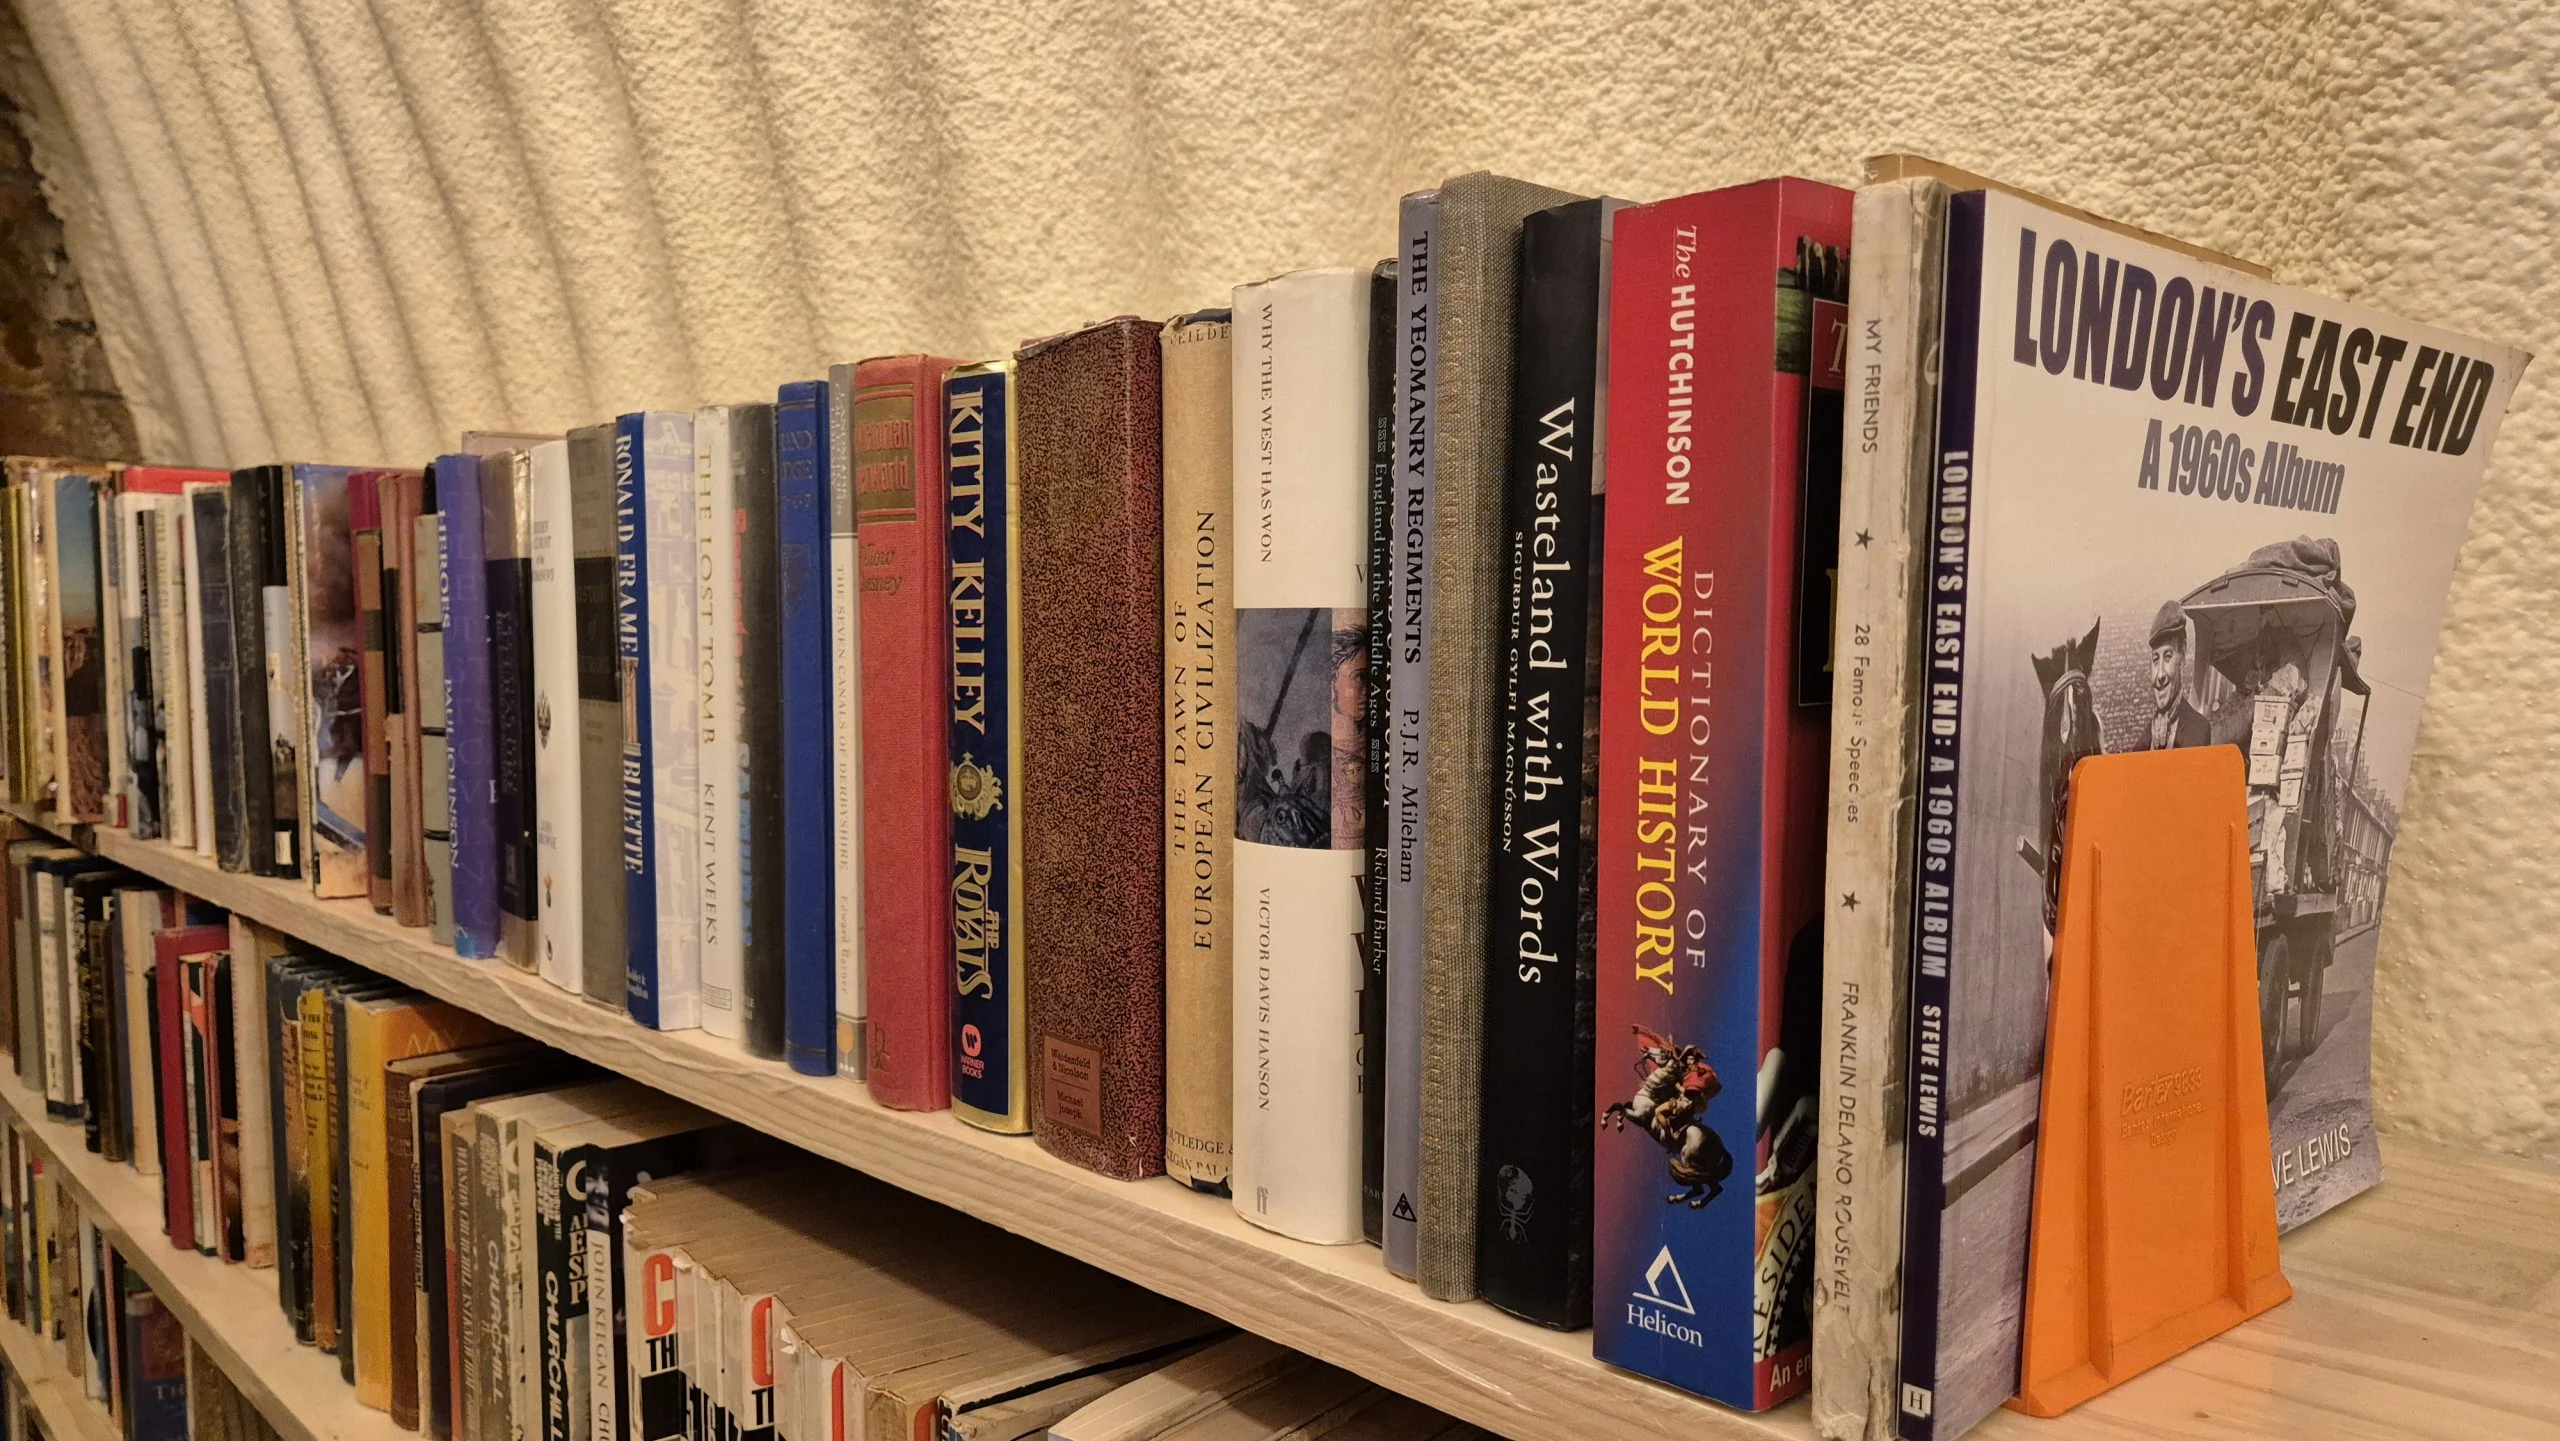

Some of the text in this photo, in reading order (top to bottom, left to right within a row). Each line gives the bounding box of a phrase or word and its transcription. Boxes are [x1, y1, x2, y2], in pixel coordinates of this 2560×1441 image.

[1665, 225, 1697, 505] The HUTCHINSON
[1862, 317, 1882, 454] MY FRIENDS
[2013, 226, 2495, 456] LONDON'S EAST END
[1260, 303, 1273, 563] WHY THE WEST HAS WON
[2137, 418, 2346, 515] A 1960s Album
[615, 433, 639, 653] RONALD FRAME
[949, 385, 985, 736] KITTY KELLEY
[1369, 463, 1387, 728] England in the Middle Ages
[1400, 230, 1428, 884] THE YEOMANRY REGIMENTS P.J.R. Mileham
[1510, 531, 1523, 640] SIGURDUR
[699, 444, 717, 945] THE LOST TOMB KENT WEEKS
[837, 605, 847, 660] SEVEN
[837, 664, 848, 731] CANALS
[1505, 647, 1520, 712] GYLFI
[1518, 397, 1575, 984] Wasteland with Words
[1855, 624, 1871, 646] 28
[1174, 600, 1187, 856] THE DAWN OF
[1194, 511, 1215, 951] EUROPEAN CIVILIZATION
[1634, 535, 1684, 996] WORLD HISTORY
[1686, 569, 1714, 968] DICTIONARY OF
[1845, 736, 1866, 824] Speeces
[1918, 451, 1969, 1138] LONDON'S EAST END: A 1960S ALBUM STEVE LEWIS
[838, 759, 849, 870] DERBYSHIRE
[1373, 847, 1388, 975] Richard Barber
[1258, 887, 1271, 1112] VICTOR DAVIS HANSON
[1839, 981, 1859, 1088] FRANKLIN
[1835, 1094, 1857, 1187] DELANO
[2298, 1123, 2352, 1179] LEWIS
[486, 1239, 502, 1404] CHURCHILL
[590, 1240, 605, 1299] JOHN
[1625, 1303, 1703, 1348] Helicon
[594, 1306, 609, 1389] KEEGAN
[1769, 1363, 1791, 1392] An
